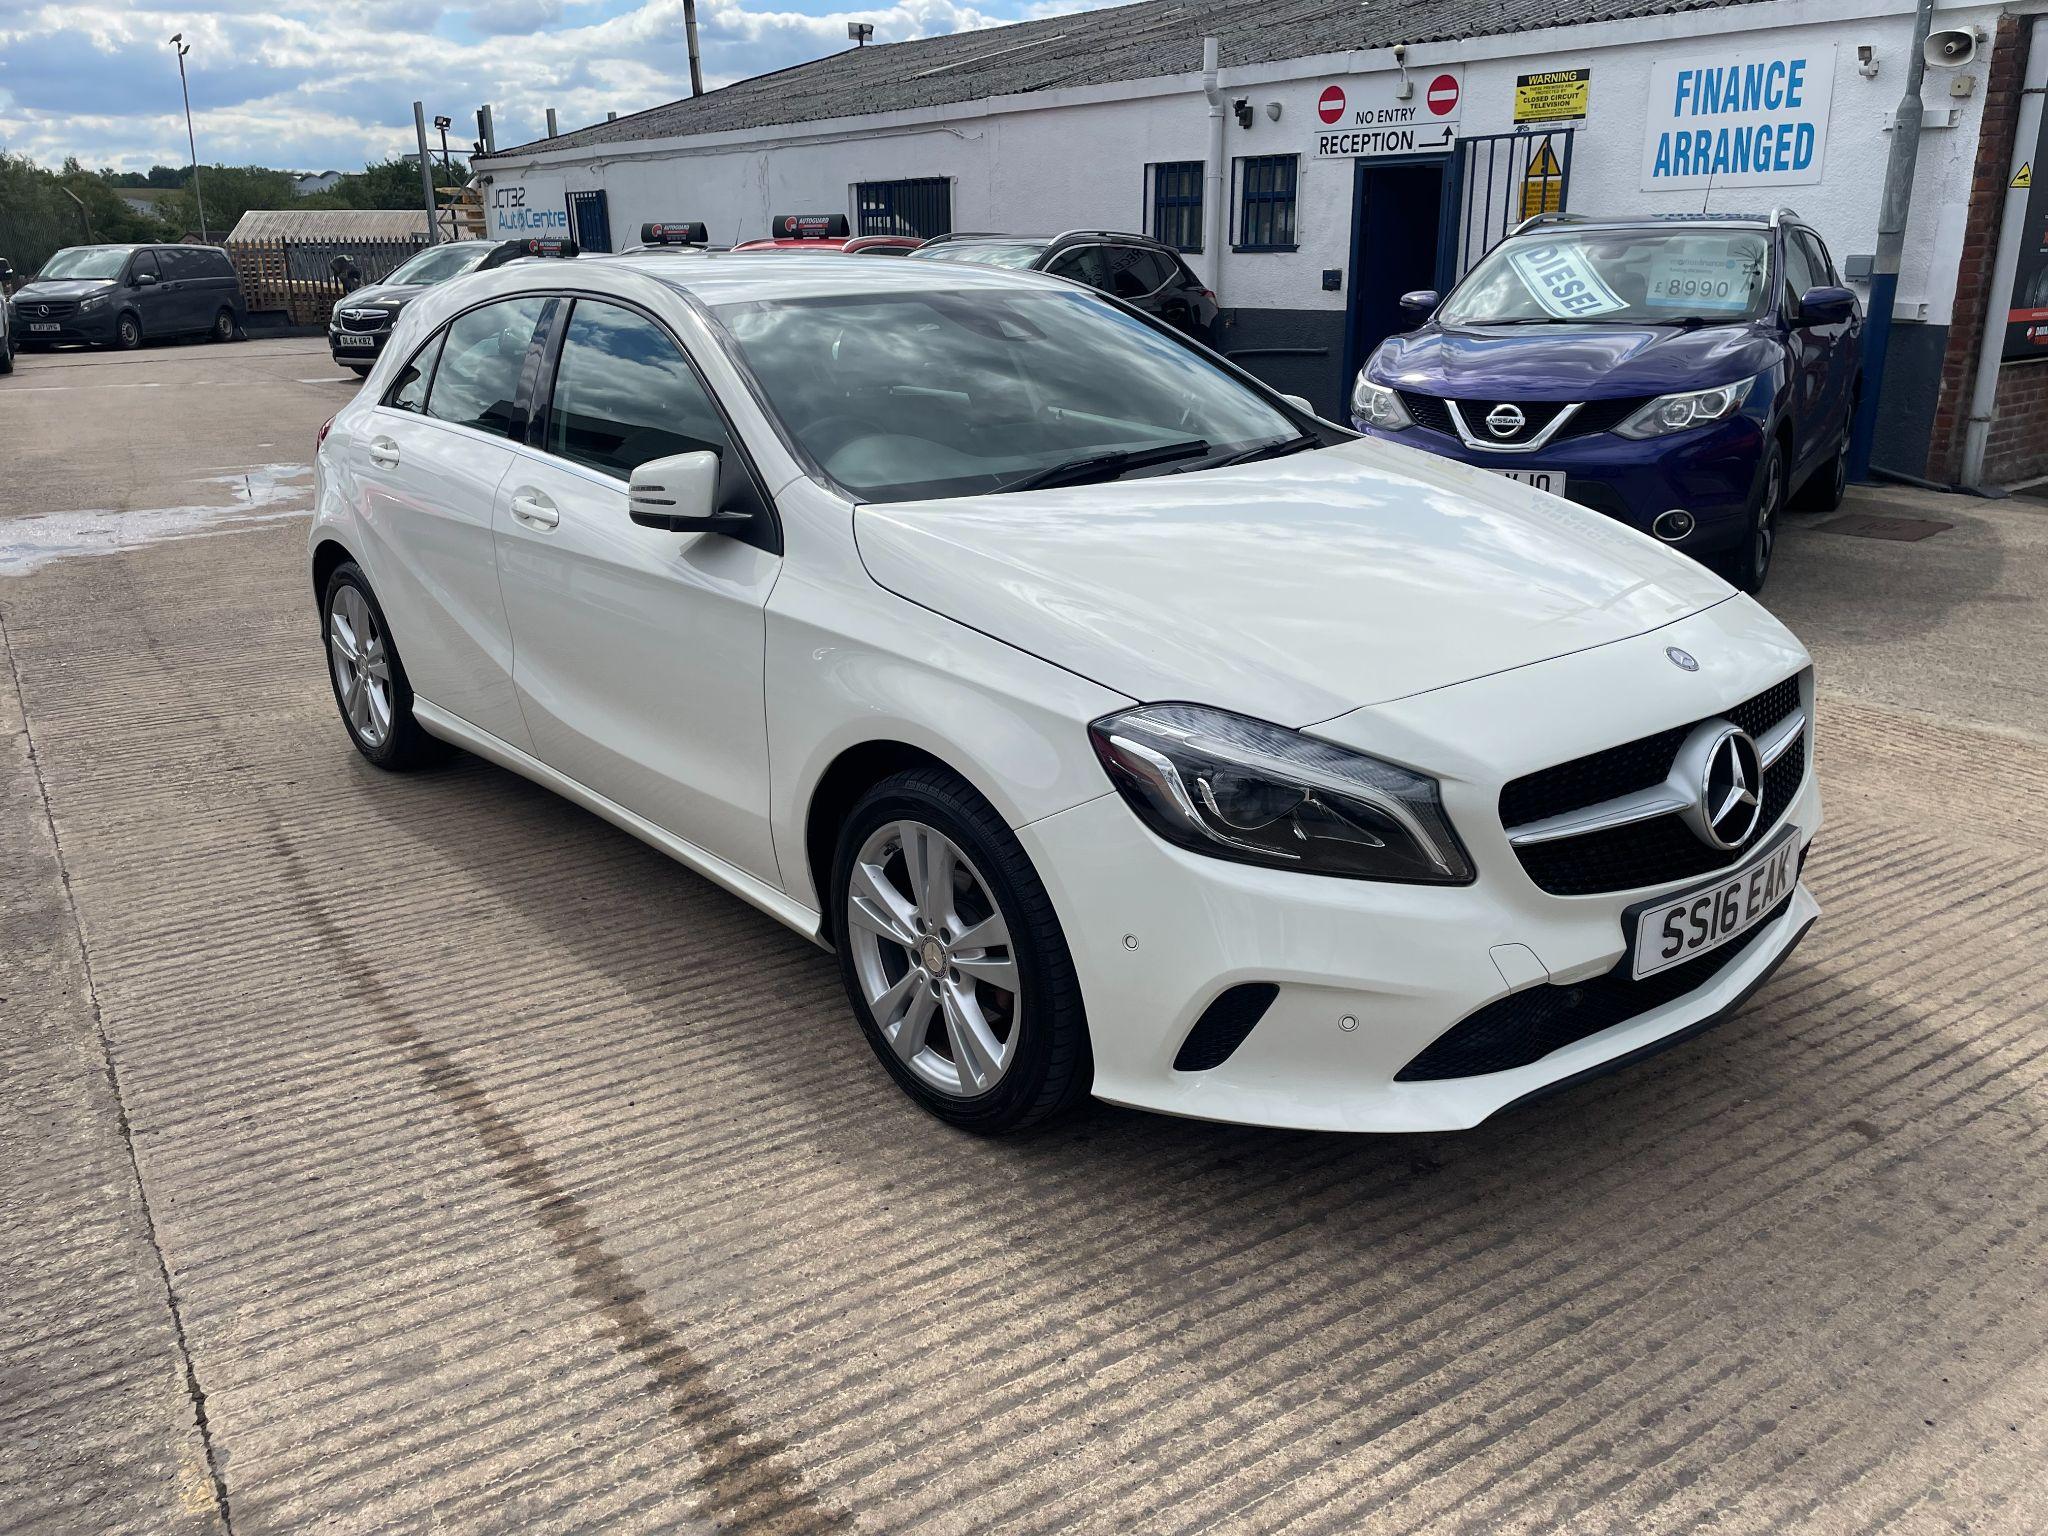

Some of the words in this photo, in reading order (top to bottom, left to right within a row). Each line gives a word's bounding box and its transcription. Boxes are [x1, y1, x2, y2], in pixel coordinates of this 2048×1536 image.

[1528, 71, 1577, 85] WARNING
[1674, 59, 1807, 117] FINANCE
[1523, 95, 1549, 104] CLOSED
[1550, 92, 1580, 101] CIRCUIT
[1530, 100, 1571, 109] TELEVISION
[1355, 110, 1374, 125] NO
[1377, 107, 1417, 123] ENTRY
[1319, 130, 1415, 155] RECEPTION
[1652, 122, 1815, 178] ARRANGED
[492, 187, 526, 208] JCT32
[1525, 244, 1603, 315] DIESEL
[1661, 882, 1742, 959] SS16
[1746, 844, 1792, 920] EAK
